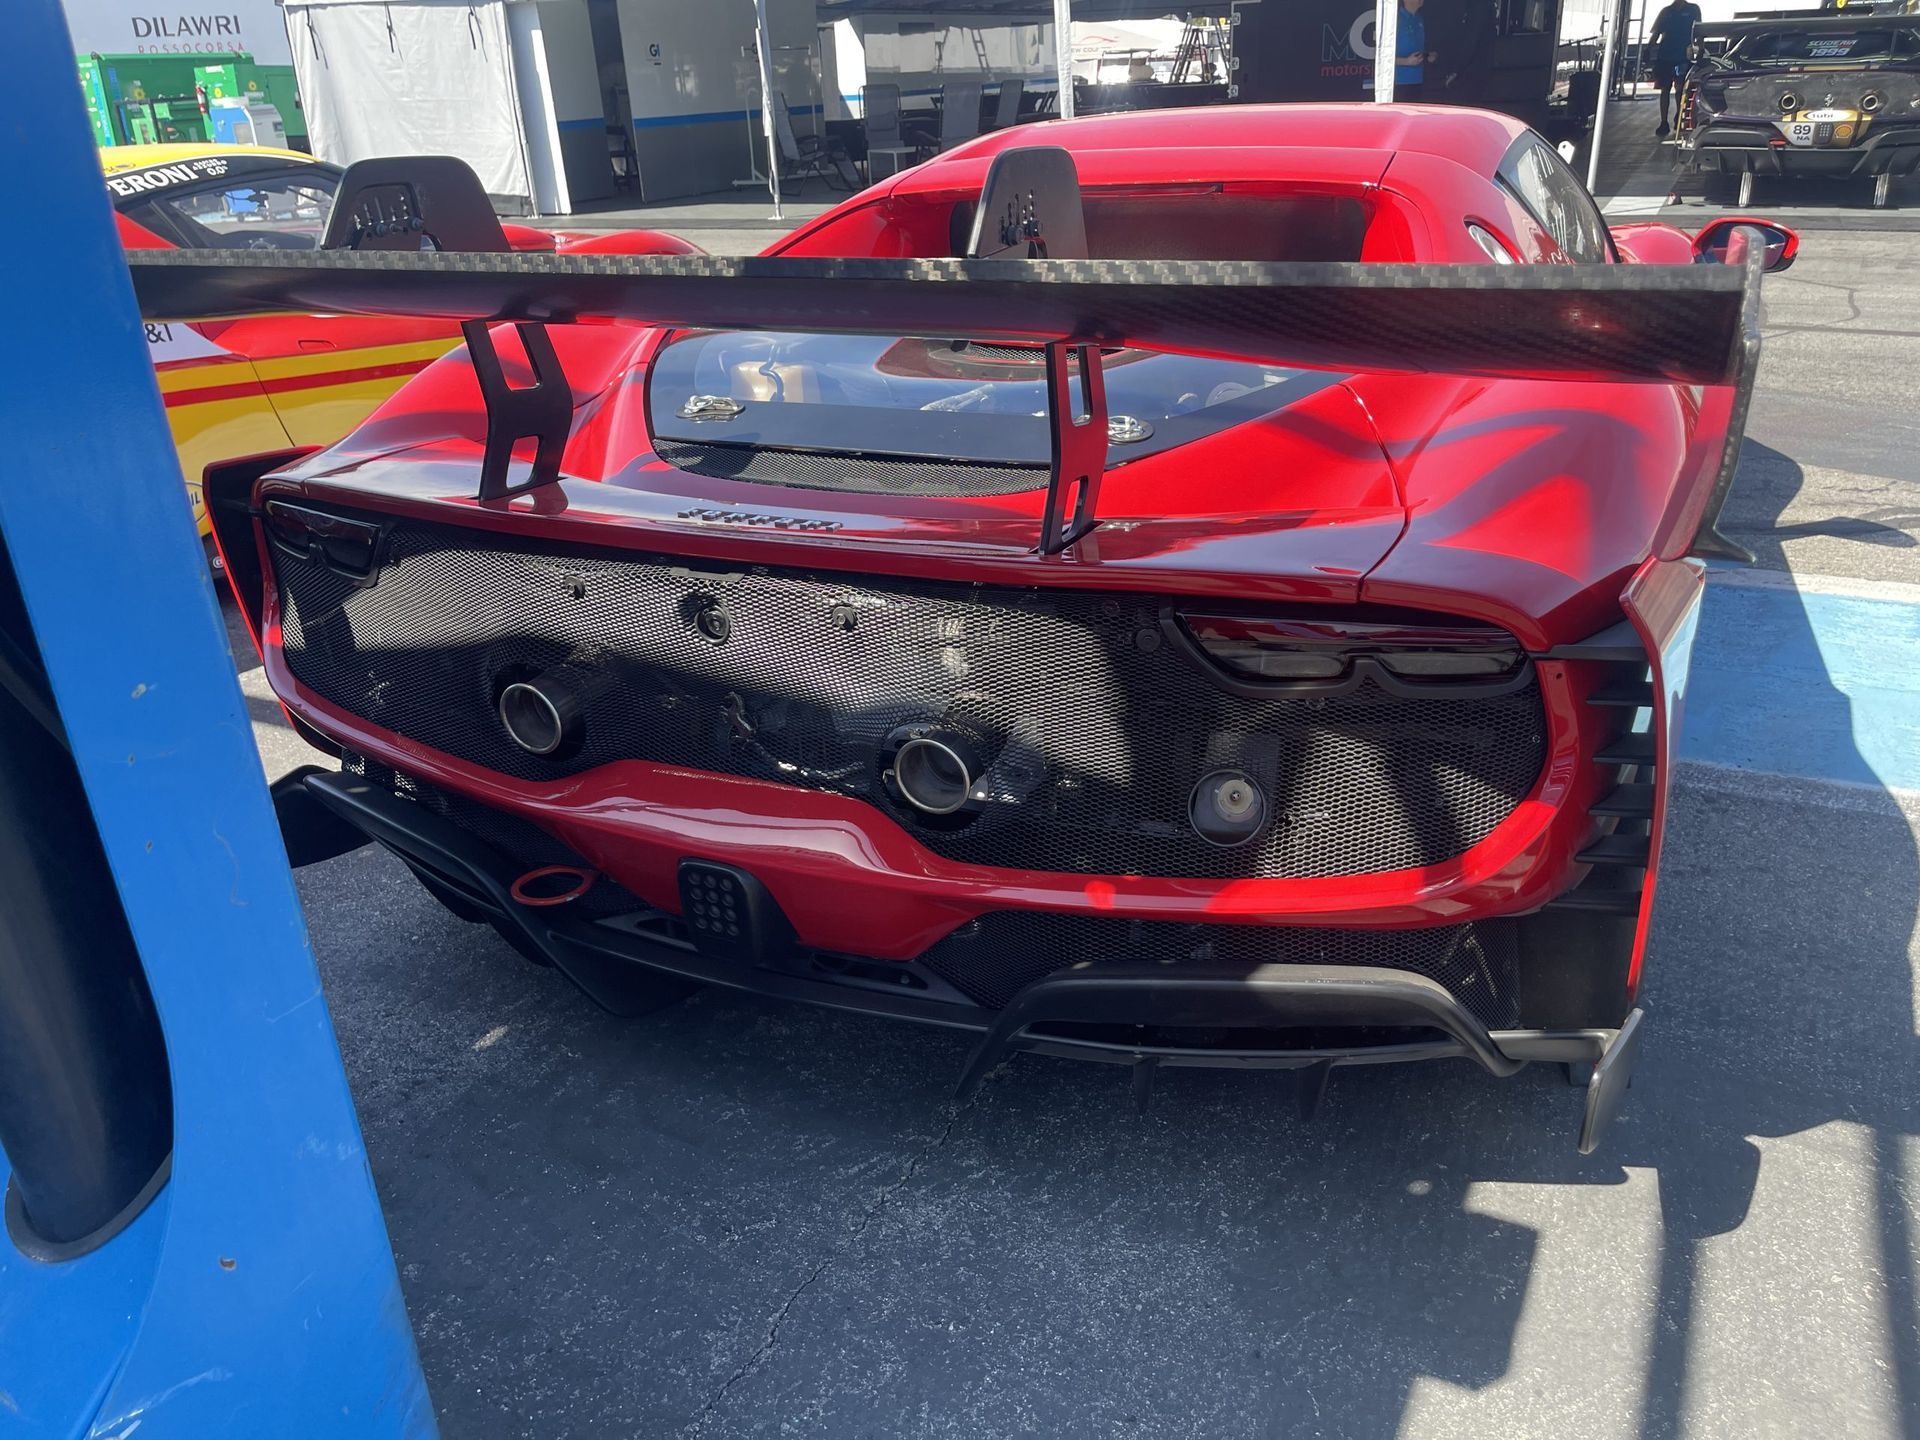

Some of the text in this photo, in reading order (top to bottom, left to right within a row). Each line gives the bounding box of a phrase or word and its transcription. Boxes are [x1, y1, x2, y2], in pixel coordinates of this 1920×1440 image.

[131, 15, 241, 38] DILAWRI
[138, 41, 245, 54] ROSSOCORSA
[1809, 48, 1851, 57] 1999
[1321, 64, 1374, 76] motors
[1793, 125, 1811, 135] 89
